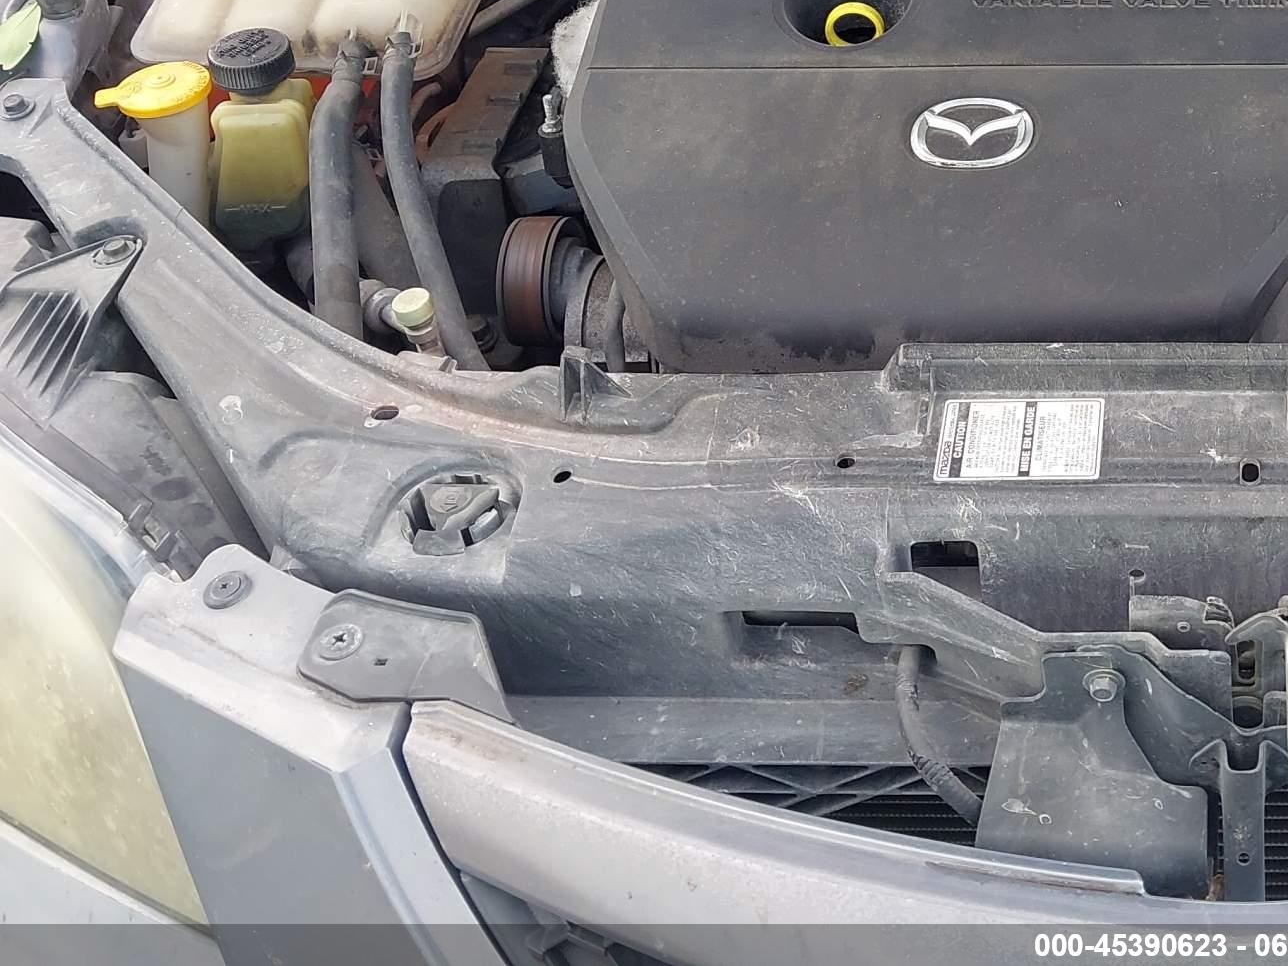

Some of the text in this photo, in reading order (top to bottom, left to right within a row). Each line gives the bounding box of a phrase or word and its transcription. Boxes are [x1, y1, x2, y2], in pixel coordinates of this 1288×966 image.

[952, 421, 967, 459] CAUTION
[965, 410, 981, 469] AIR CONDITIONER
[1019, 406, 1037, 472] MISE EN GARDE
